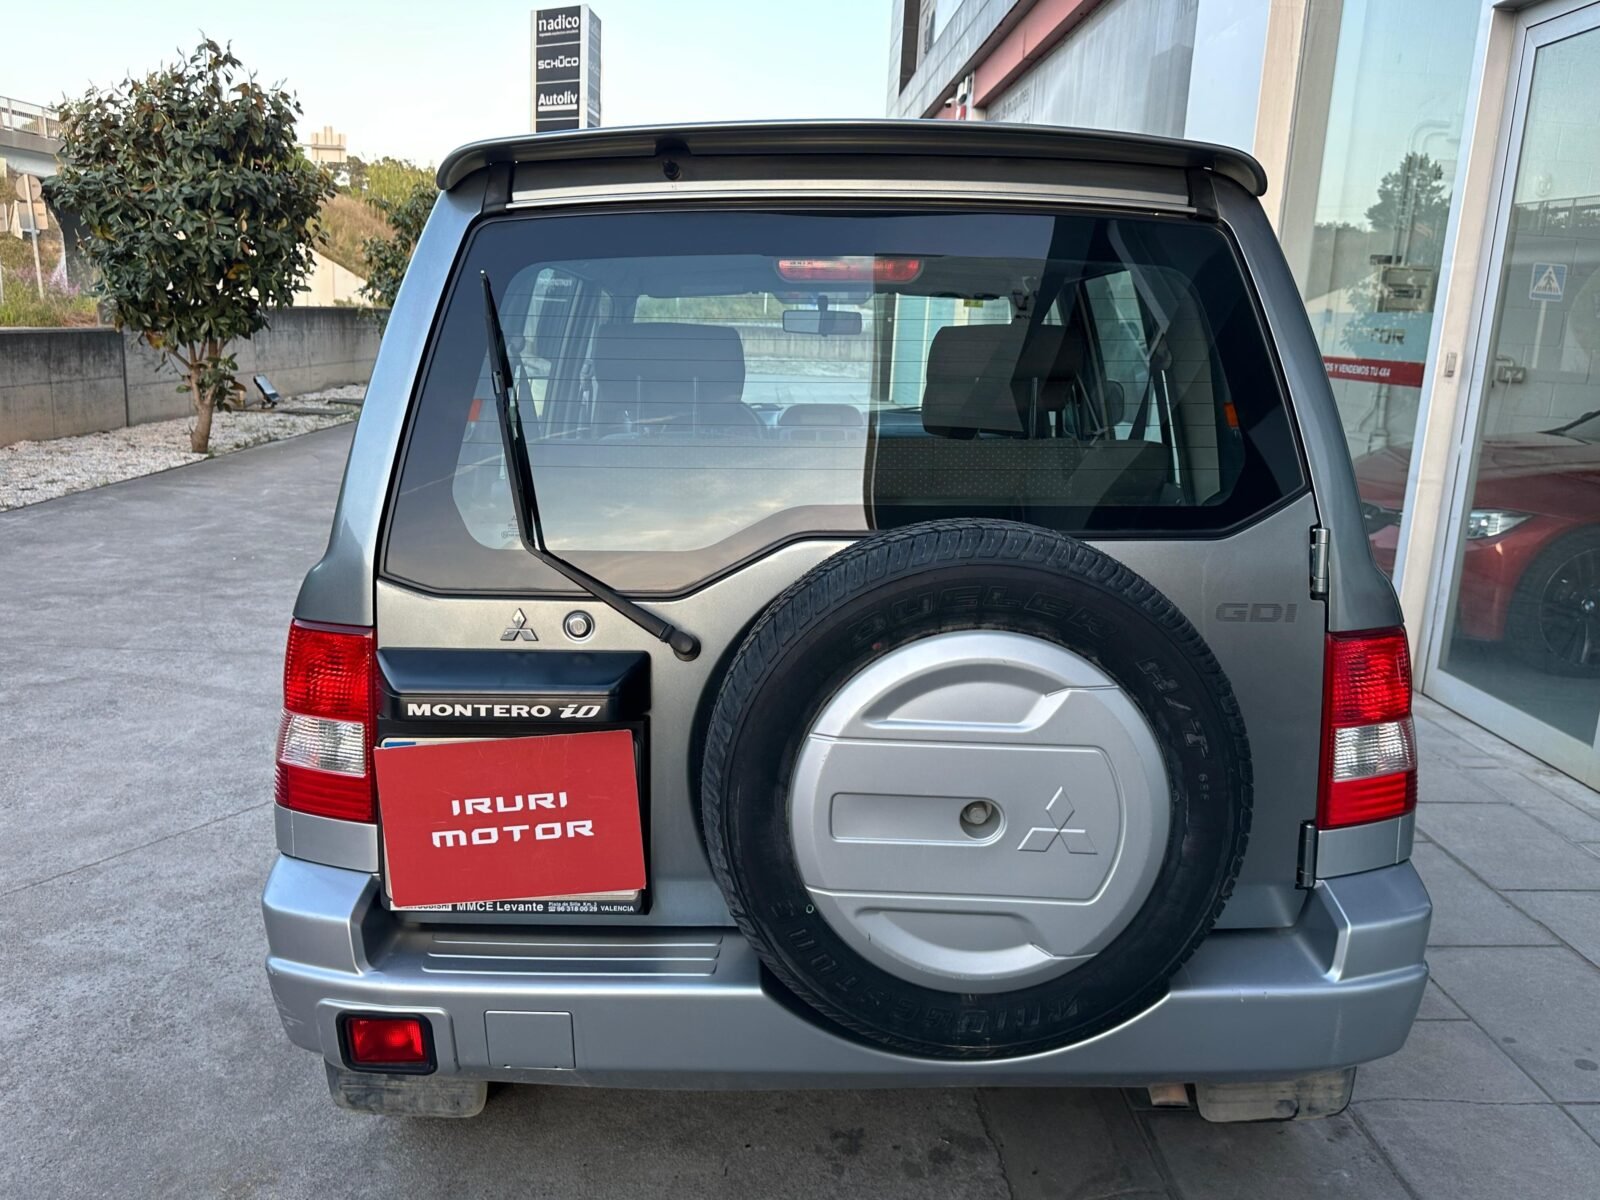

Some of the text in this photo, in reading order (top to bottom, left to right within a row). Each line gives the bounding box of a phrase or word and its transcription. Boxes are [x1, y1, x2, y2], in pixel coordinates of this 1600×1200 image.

[538, 14, 579, 31] nadico
[538, 91, 578, 105] Autoliv
[1215, 603, 1298, 623] GDI
[407, 703, 552, 717] MONTERO
[451, 792, 568, 816] IRURI
[431, 820, 595, 848] MOTOR
[456, 902, 494, 911] MMCE
[496, 902, 544, 911] Levante
